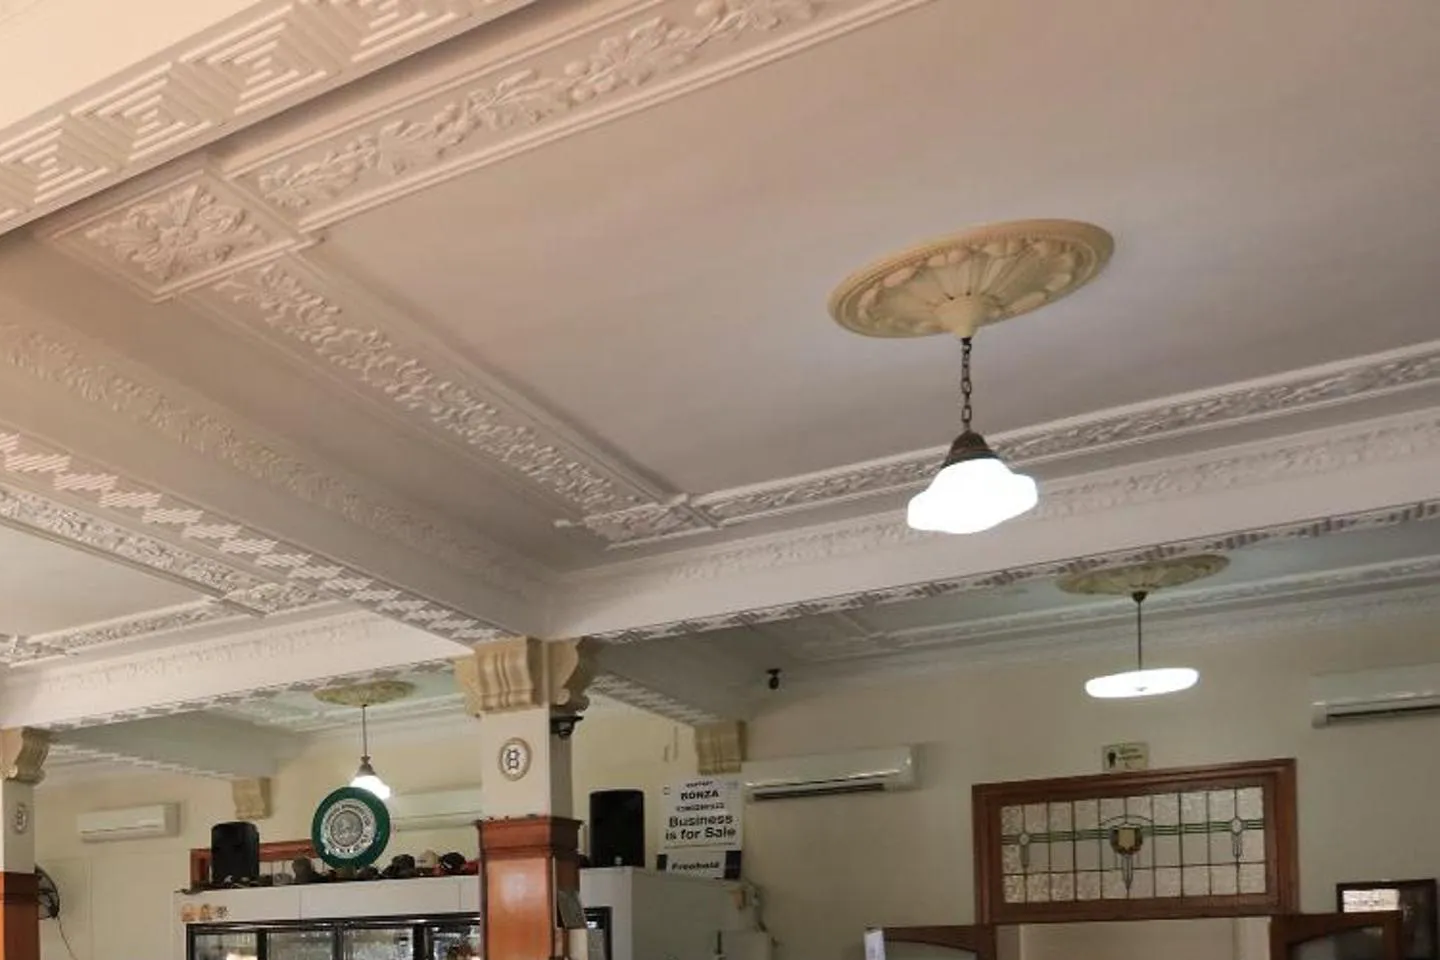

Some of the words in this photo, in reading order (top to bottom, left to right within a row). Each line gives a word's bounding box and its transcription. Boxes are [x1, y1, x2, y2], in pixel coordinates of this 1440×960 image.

[669, 815, 733, 828] Business
[665, 830, 677, 840] is
[681, 829, 701, 840] for
[705, 826, 736, 838] Sale
